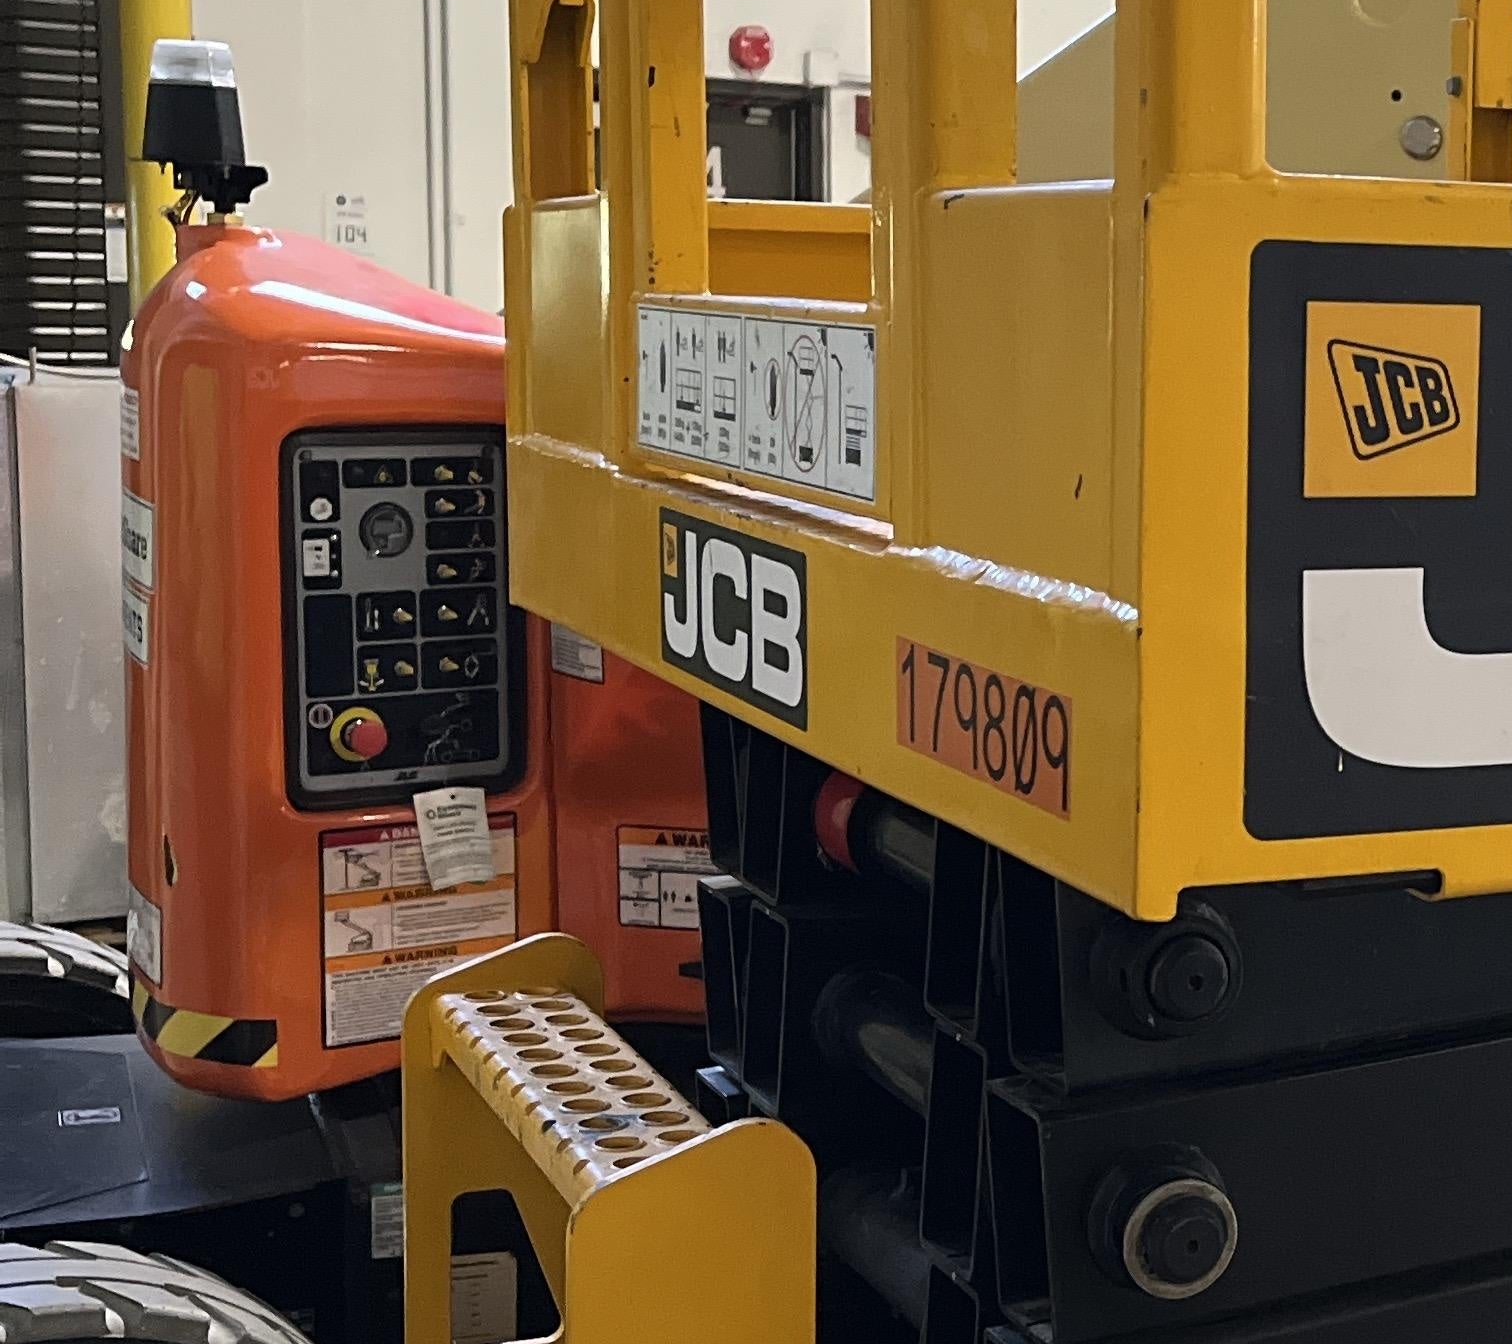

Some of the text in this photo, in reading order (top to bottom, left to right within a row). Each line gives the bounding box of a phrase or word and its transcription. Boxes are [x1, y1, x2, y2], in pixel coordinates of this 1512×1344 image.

[1351, 353, 1451, 447] JCB
[663, 529, 804, 708] JCB
[902, 643, 1069, 813] 179809
